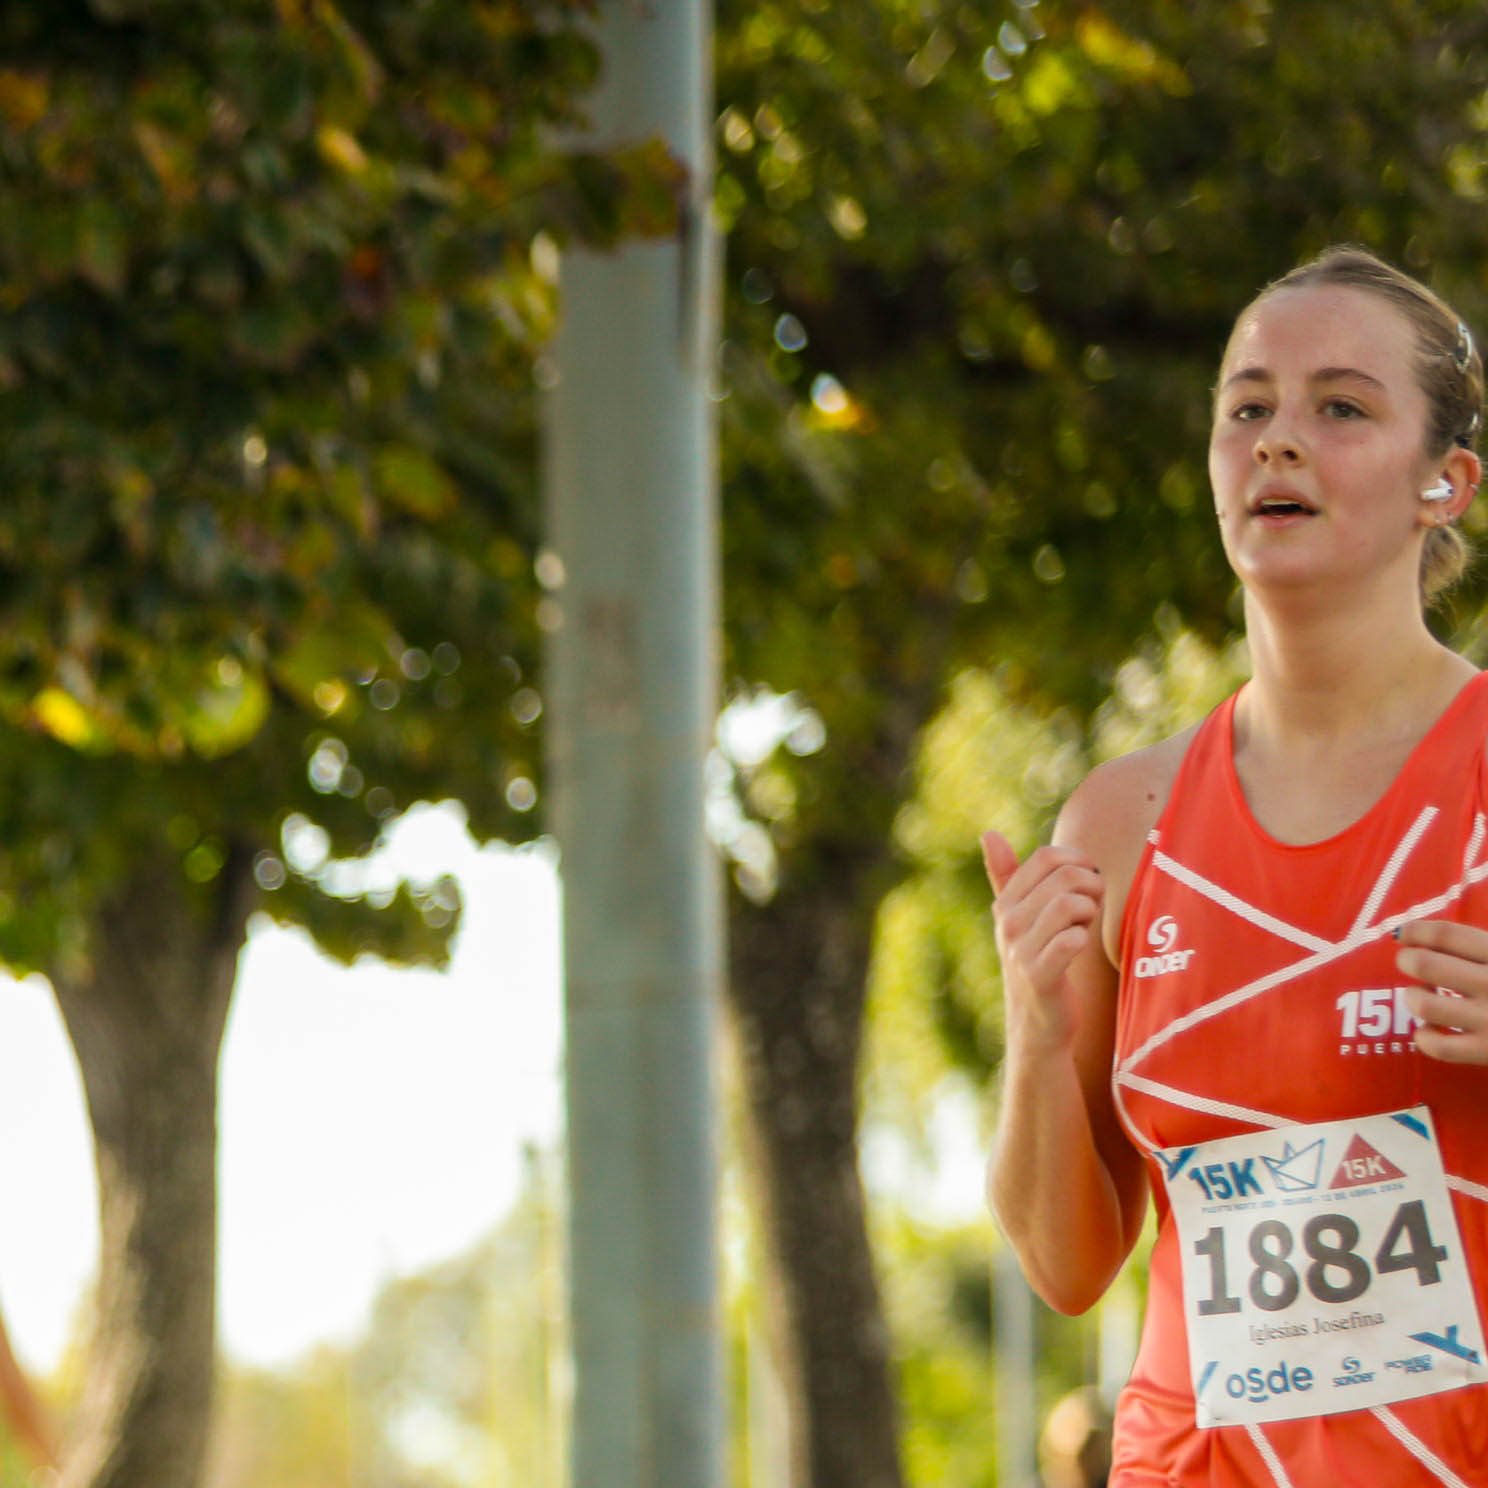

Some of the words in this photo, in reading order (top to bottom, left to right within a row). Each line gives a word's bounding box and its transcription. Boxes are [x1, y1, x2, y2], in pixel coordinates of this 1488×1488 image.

[1339, 1041, 1417, 1056] PUERT
[1187, 1156, 1264, 1201] 15K
[1342, 1154, 1387, 1181] 15K
[1193, 1199, 1449, 1317] 1884
[1249, 1321, 1309, 1346] Iglesias
[1311, 1310, 1386, 1335] Josefina
[1225, 1360, 1314, 1403] osde
